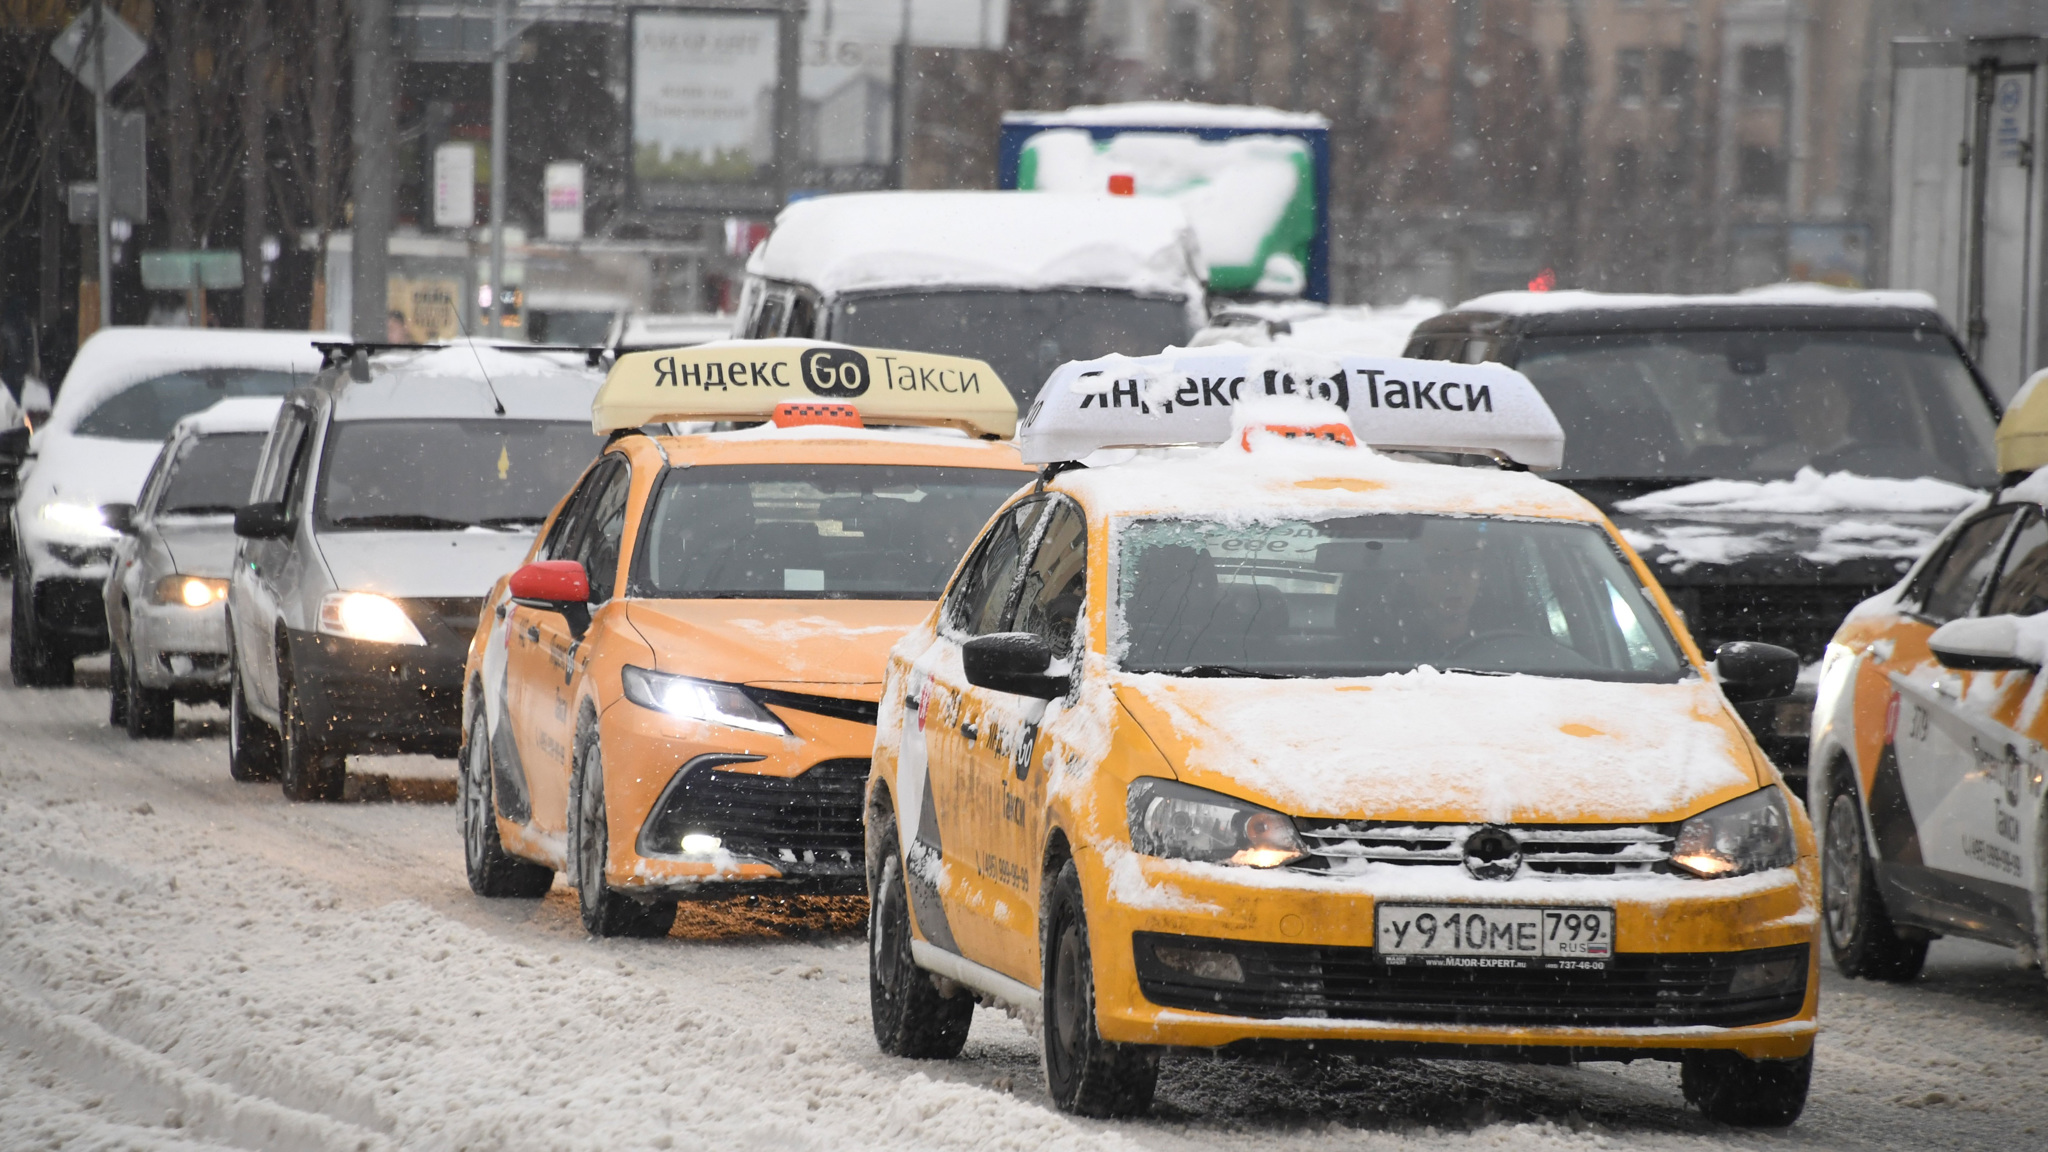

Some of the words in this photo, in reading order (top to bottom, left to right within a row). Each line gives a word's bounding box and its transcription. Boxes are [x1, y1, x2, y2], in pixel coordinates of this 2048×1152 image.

[653, 355, 791, 392] Яндекс
[809, 352, 863, 391] Go
[875, 356, 981, 394] Такси
[1356, 369, 1493, 413] Такси
[1391, 912, 1537, 952] У910МЕ
[1545, 912, 1601, 942] 799
[1559, 943, 1587, 953] RUS
[1558, 960, 1605, 970] 737-46-00
